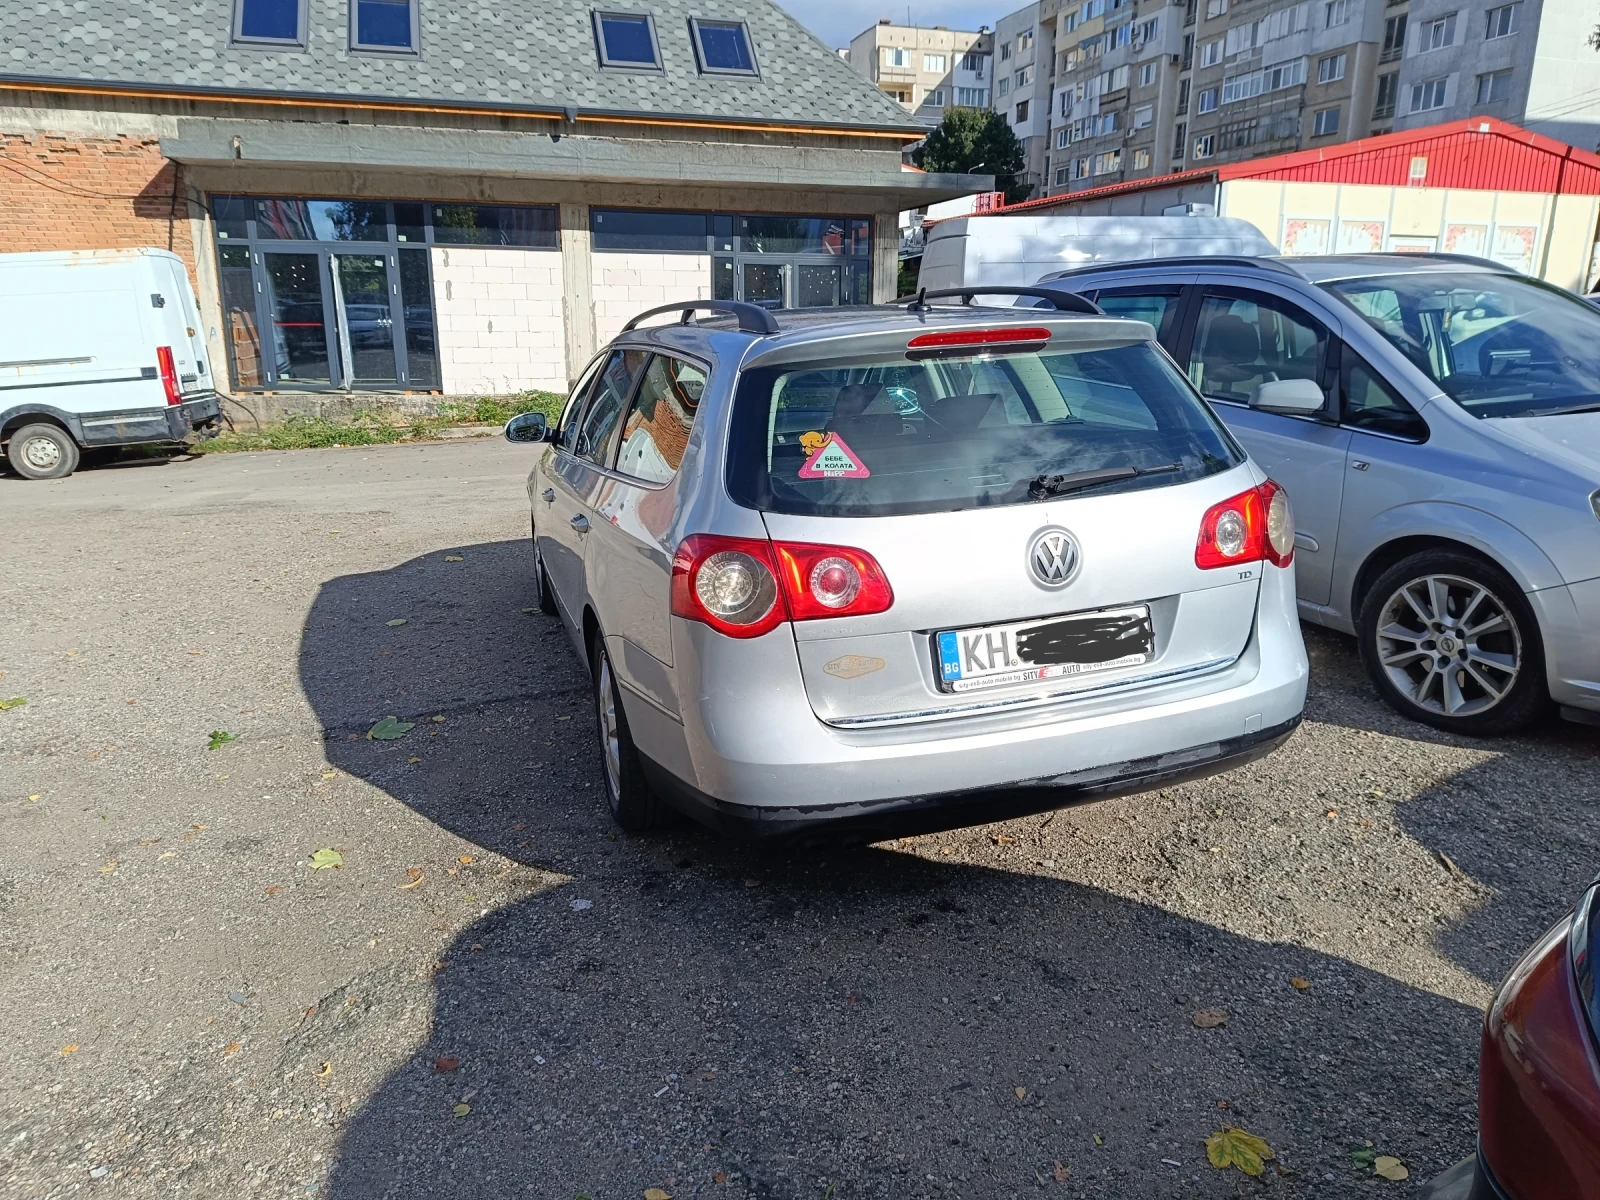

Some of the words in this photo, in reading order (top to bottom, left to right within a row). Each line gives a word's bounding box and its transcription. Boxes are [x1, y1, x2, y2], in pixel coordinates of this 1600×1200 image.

[1031, 531, 1079, 584] VW
[962, 630, 1010, 672] KH
[944, 661, 959, 674] BG
[1022, 670, 1039, 681] SITY
[1062, 664, 1081, 674] AUTO
